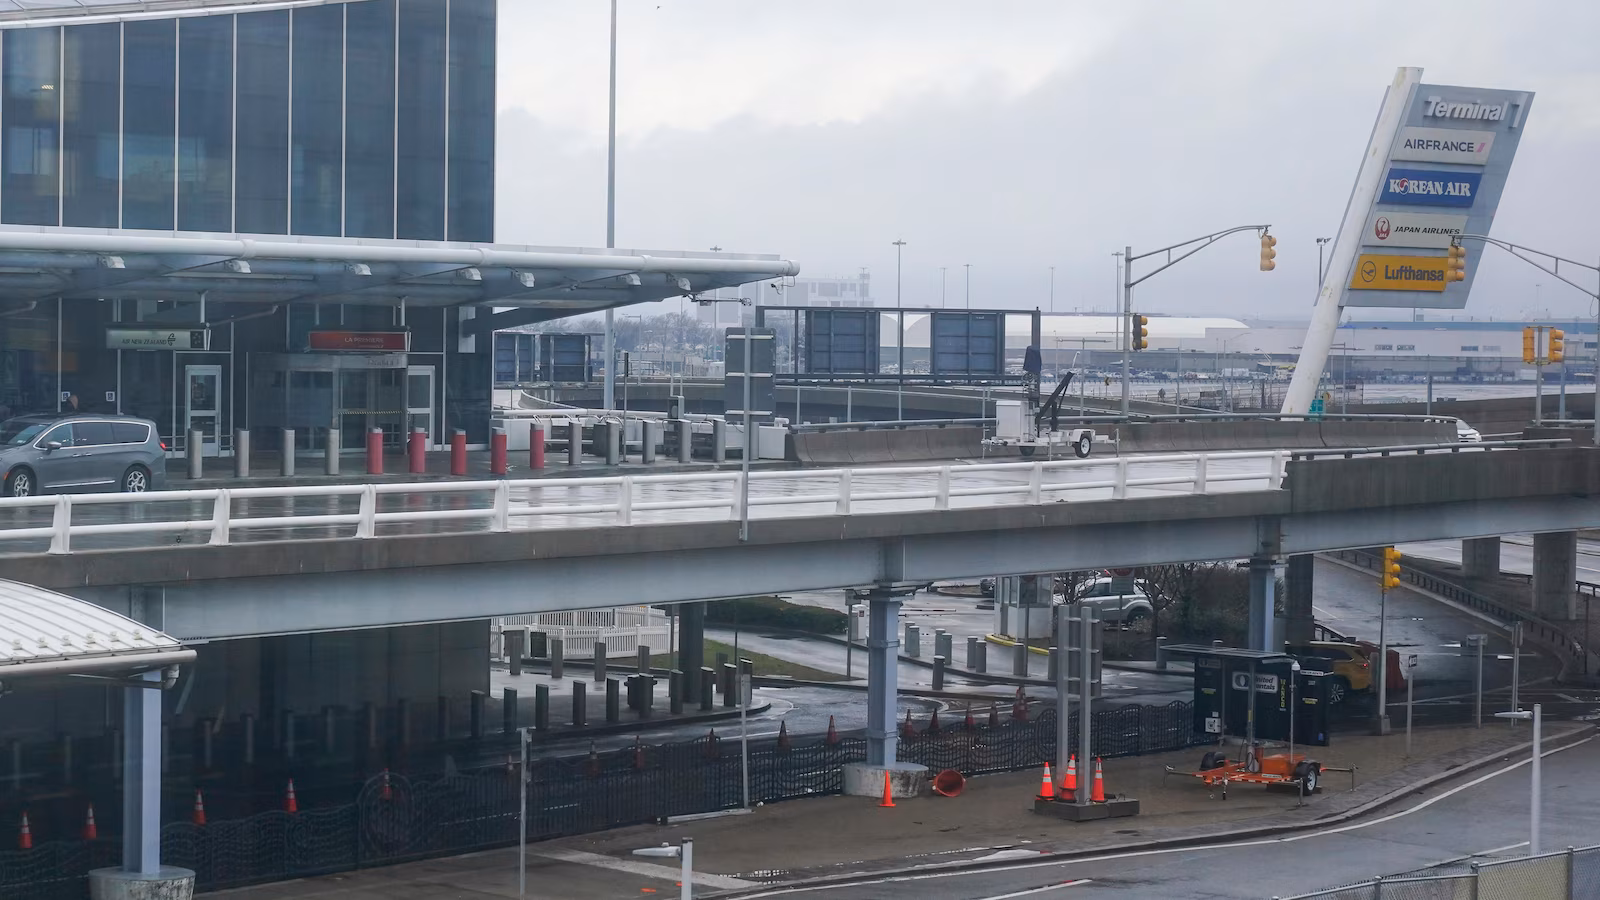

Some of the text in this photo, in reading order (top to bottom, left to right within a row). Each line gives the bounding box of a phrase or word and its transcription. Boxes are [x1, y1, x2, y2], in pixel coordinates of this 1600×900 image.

[1424, 96, 1509, 121] Terminal
[1404, 138, 1474, 153] AIRFRANCE
[1389, 178, 1471, 197] KOREAN AIR
[1422, 227, 1461, 235] AIRLINES
[1384, 265, 1445, 281] Lufthansa
[1255, 676, 1274, 684] nited
